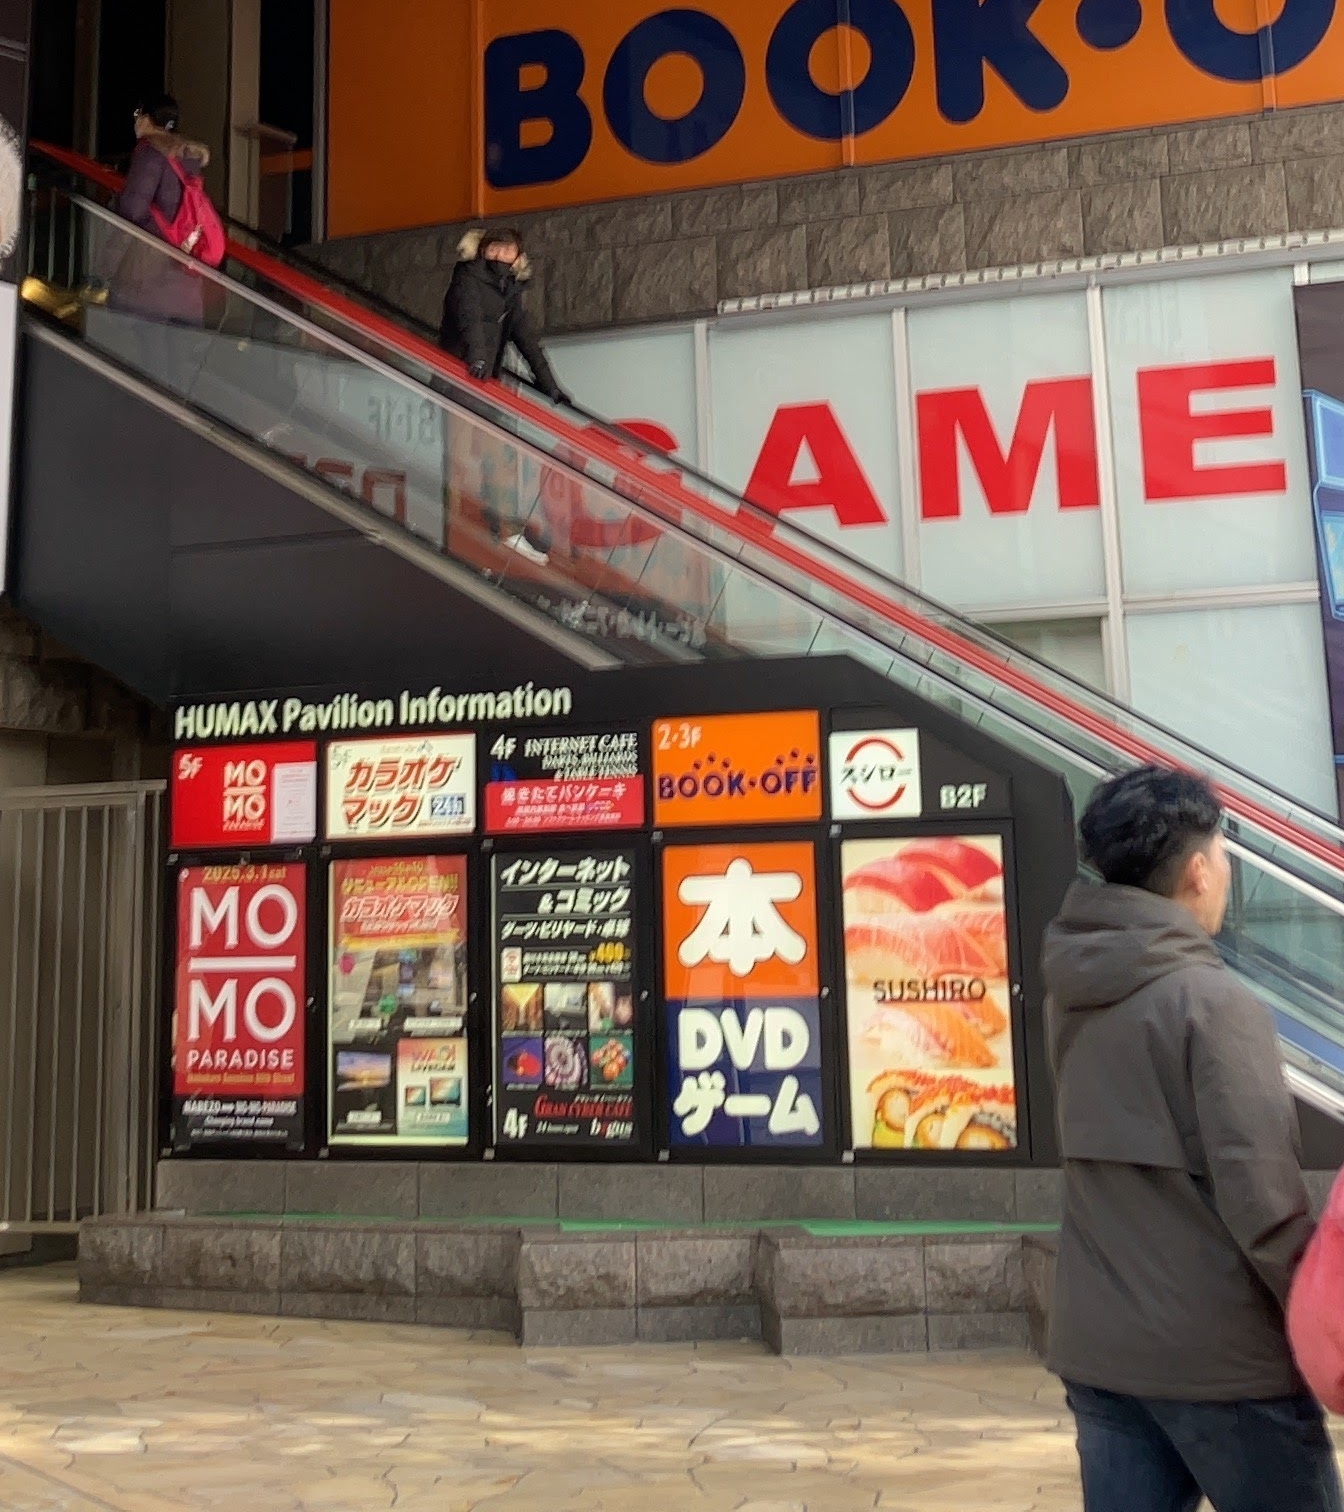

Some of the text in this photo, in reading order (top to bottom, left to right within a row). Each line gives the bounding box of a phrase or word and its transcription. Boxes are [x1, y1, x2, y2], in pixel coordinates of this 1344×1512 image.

[174, 681, 572, 739] HUMAX Pavilion Information
[490, 734, 517, 760] 4F
[524, 733, 637, 757] INTERNET CAFE
[178, 753, 203, 780] 5F
[224, 759, 267, 787] MO
[345, 753, 463, 792] カラオケ
[841, 762, 912, 786] スシロー
[223, 793, 266, 821] MO
[939, 784, 987, 808] B2F
[343, 793, 422, 829] マック
[500, 855, 631, 886] インターネット
[340, 894, 460, 923] カラオケマック
[538, 885, 631, 914] &コミック
[189, 884, 297, 950] MO
[677, 857, 808, 975] 本
[872, 978, 987, 1002] SUSHIRO
[186, 977, 296, 1043] MO
[677, 1006, 810, 1071] DVD
[187, 1048, 294, 1070] PARADISE
[673, 1070, 820, 1137] ゲーム
[503, 1107, 528, 1138] 4F
